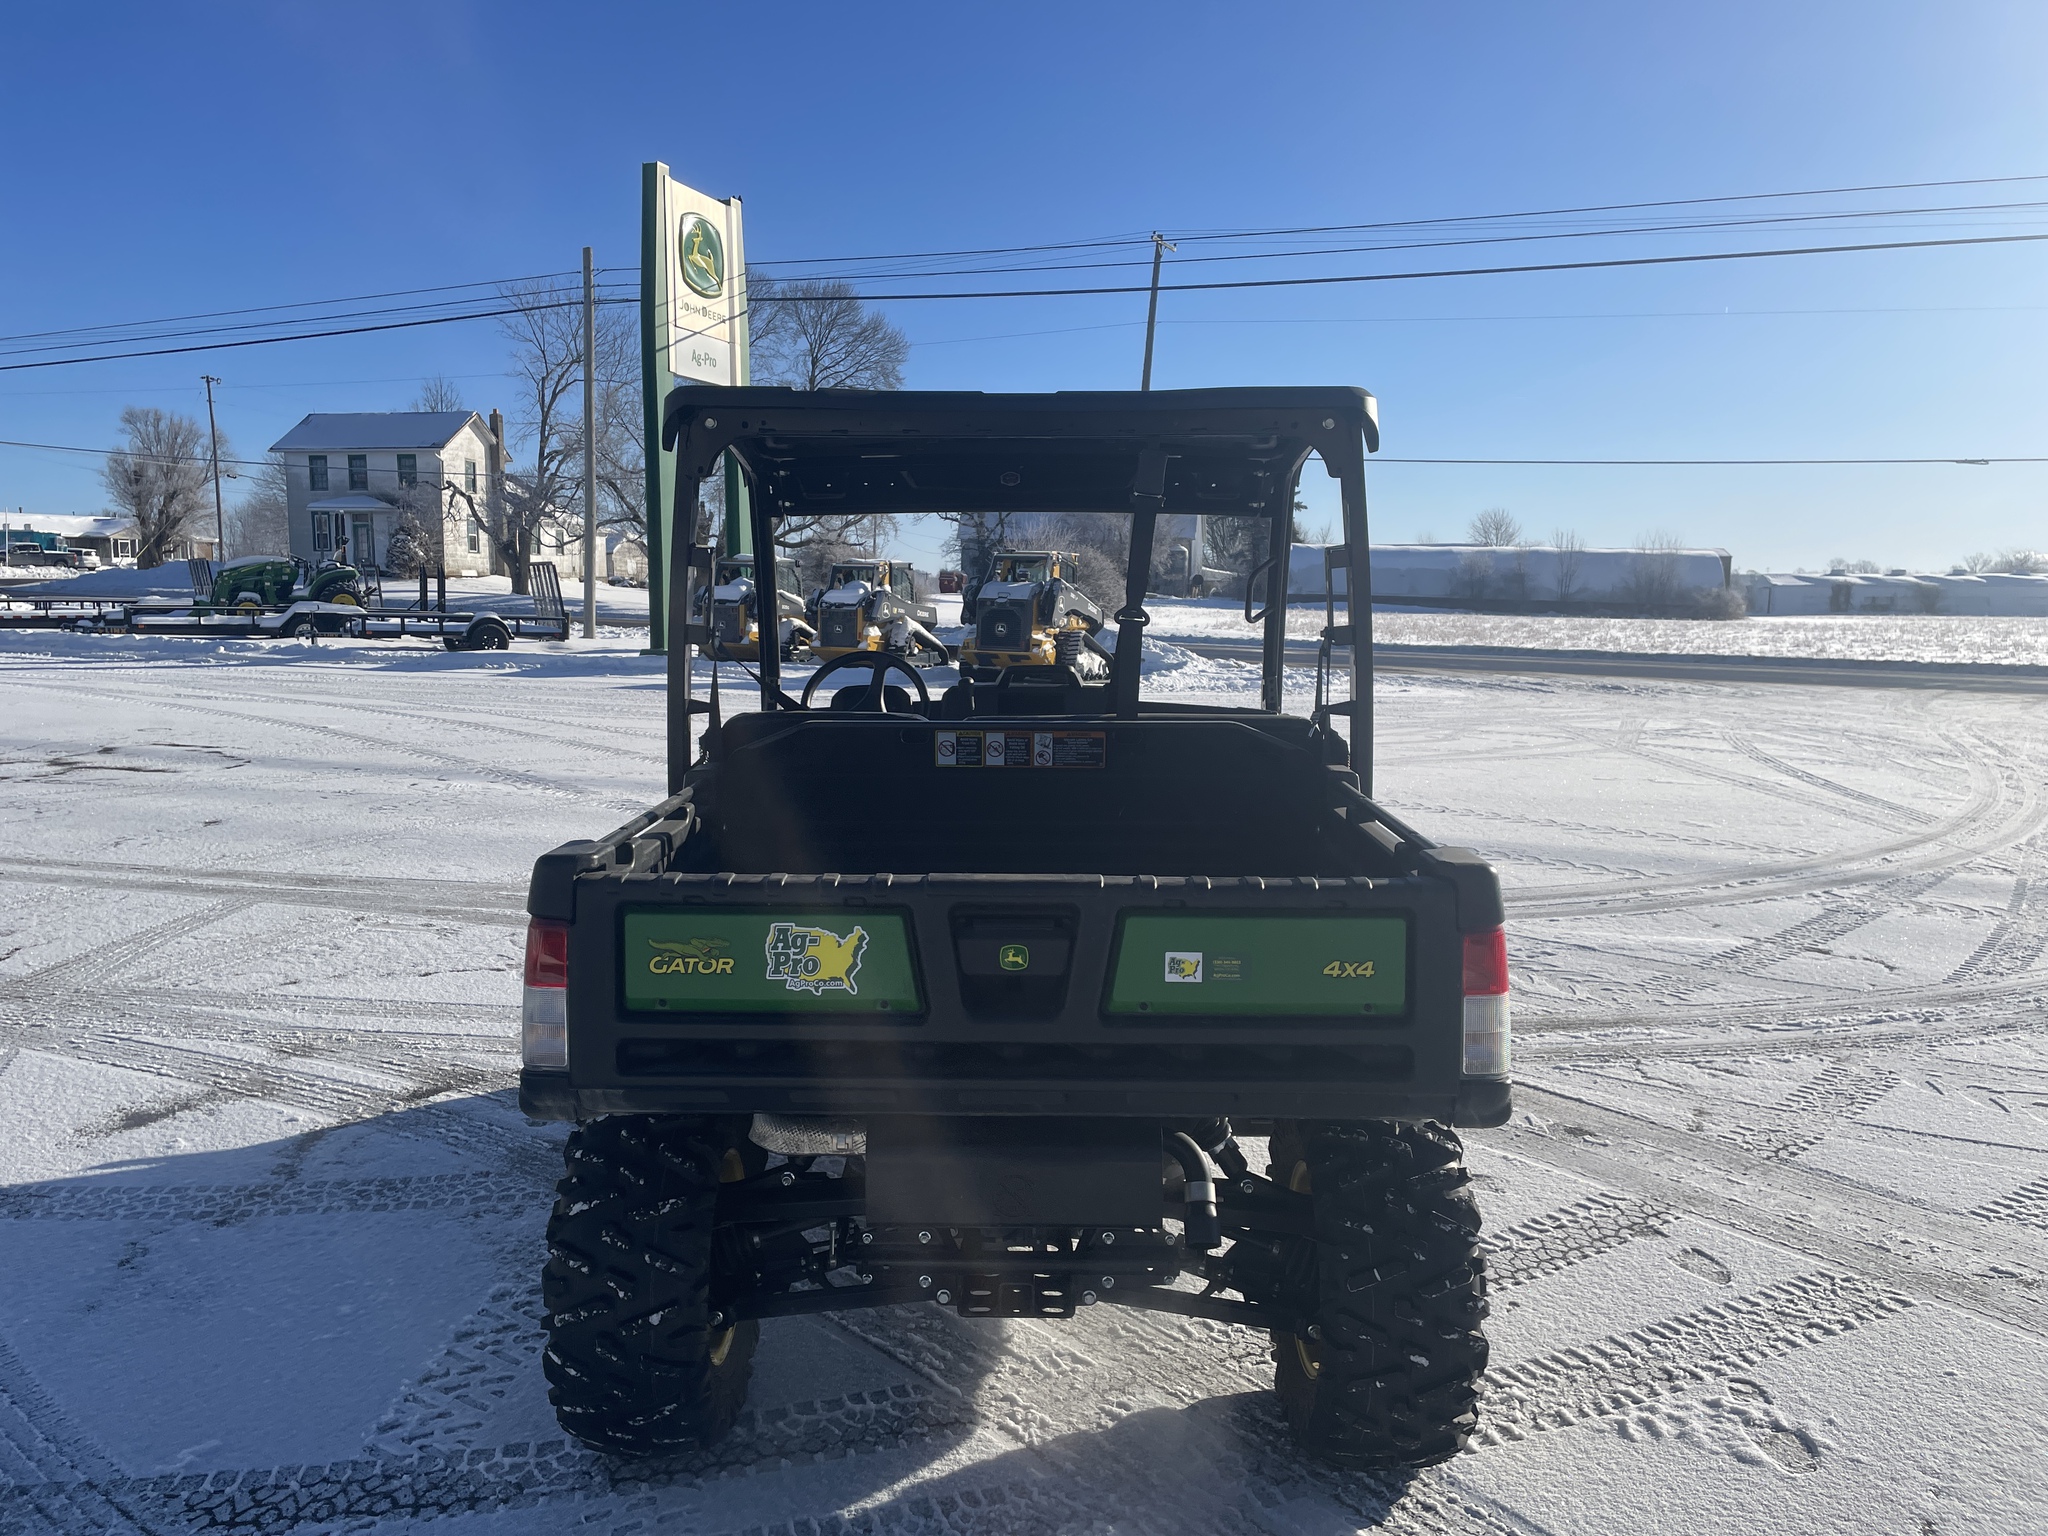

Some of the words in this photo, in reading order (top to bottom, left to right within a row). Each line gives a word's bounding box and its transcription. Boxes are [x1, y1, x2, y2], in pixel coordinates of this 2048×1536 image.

[679, 299, 701, 316] JOHN
[701, 307, 727, 324] DEERE
[691, 349, 717, 368] Ag-Pro
[770, 925, 821, 956] Ag-
[648, 956, 735, 975] GATOR
[769, 952, 821, 977] Pro
[1168, 965, 1185, 975] Pro
[788, 979, 844, 991] AgProCo.com
